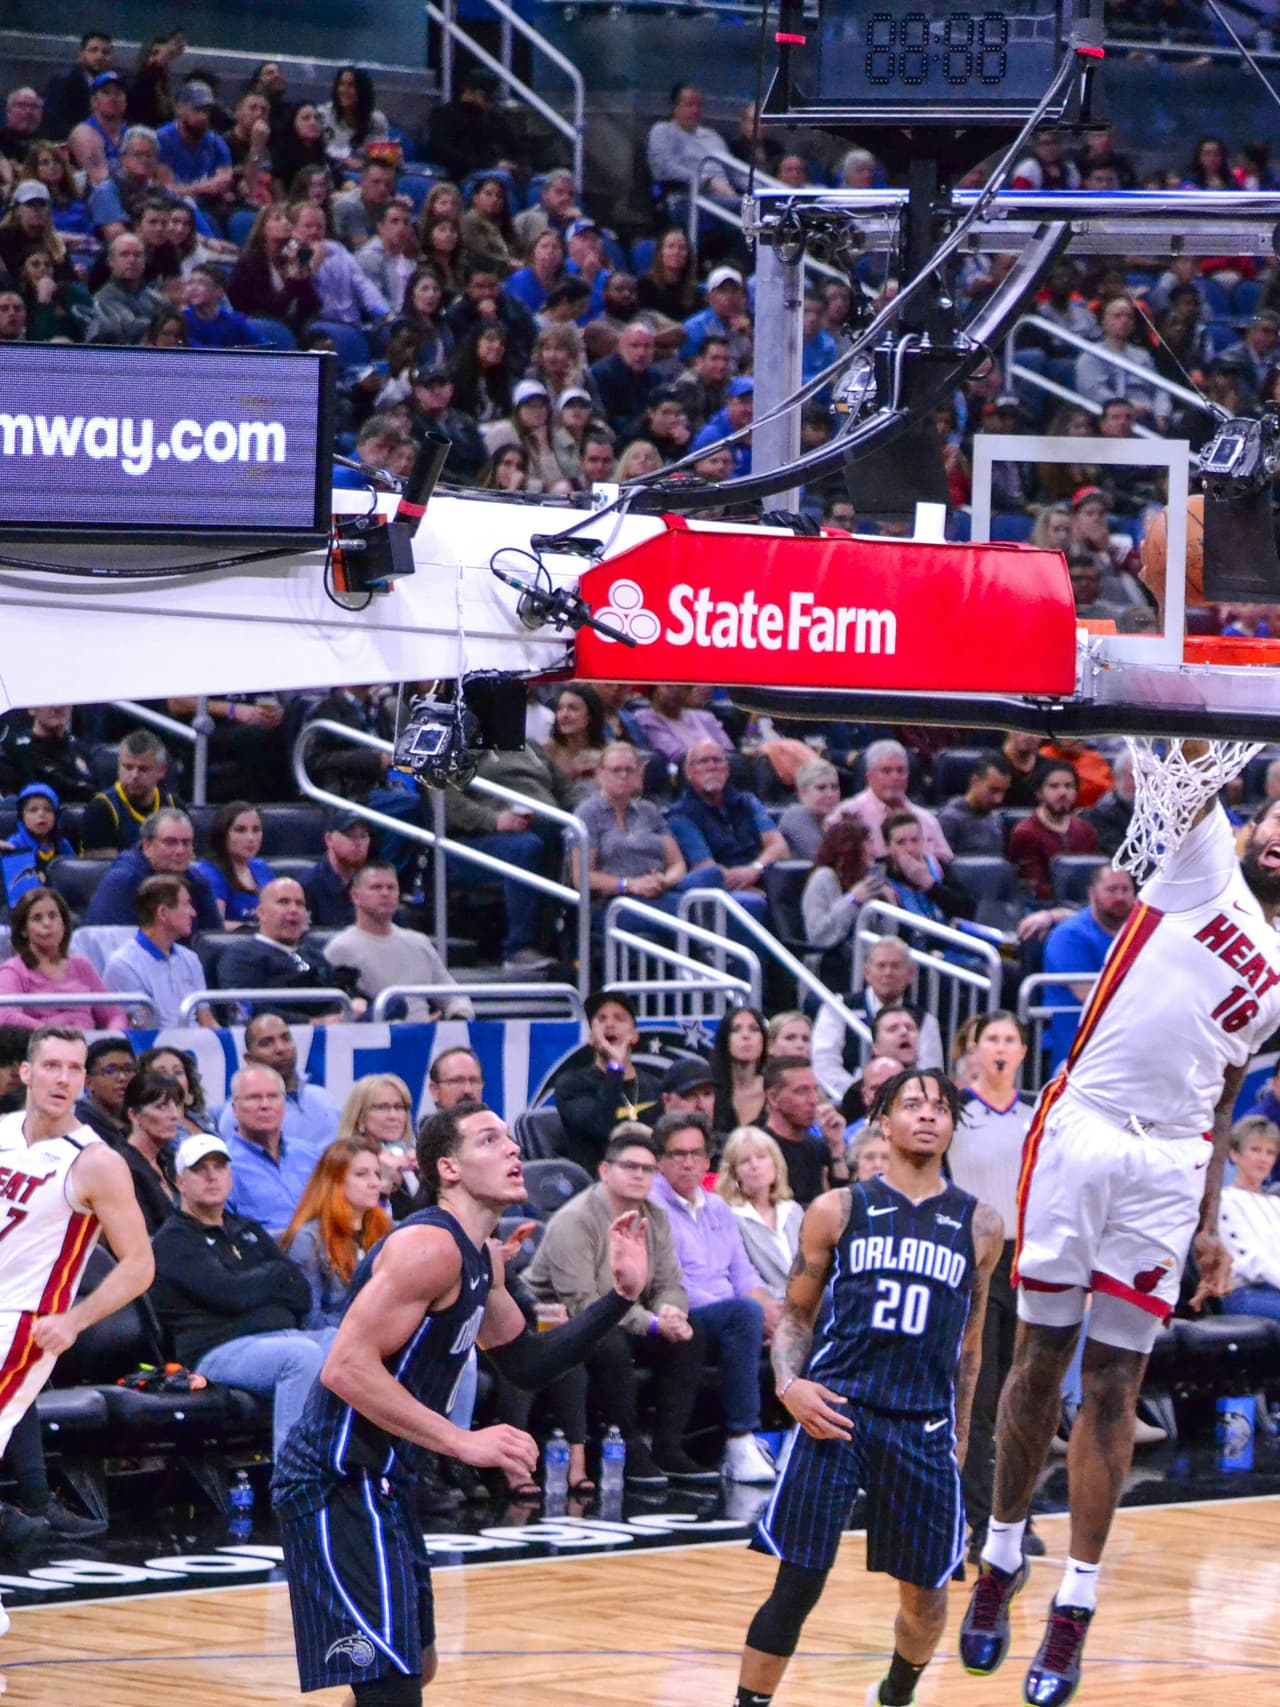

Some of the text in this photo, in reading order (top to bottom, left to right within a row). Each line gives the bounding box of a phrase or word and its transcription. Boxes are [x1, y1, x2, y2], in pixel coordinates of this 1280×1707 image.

[0, 413, 286, 475] mway.com
[1211, 985, 1259, 1033] 16
[0, 1206, 28, 1241] 7
[850, 1236, 966, 1289] ORLANDO
[871, 1278, 930, 1336] 20
